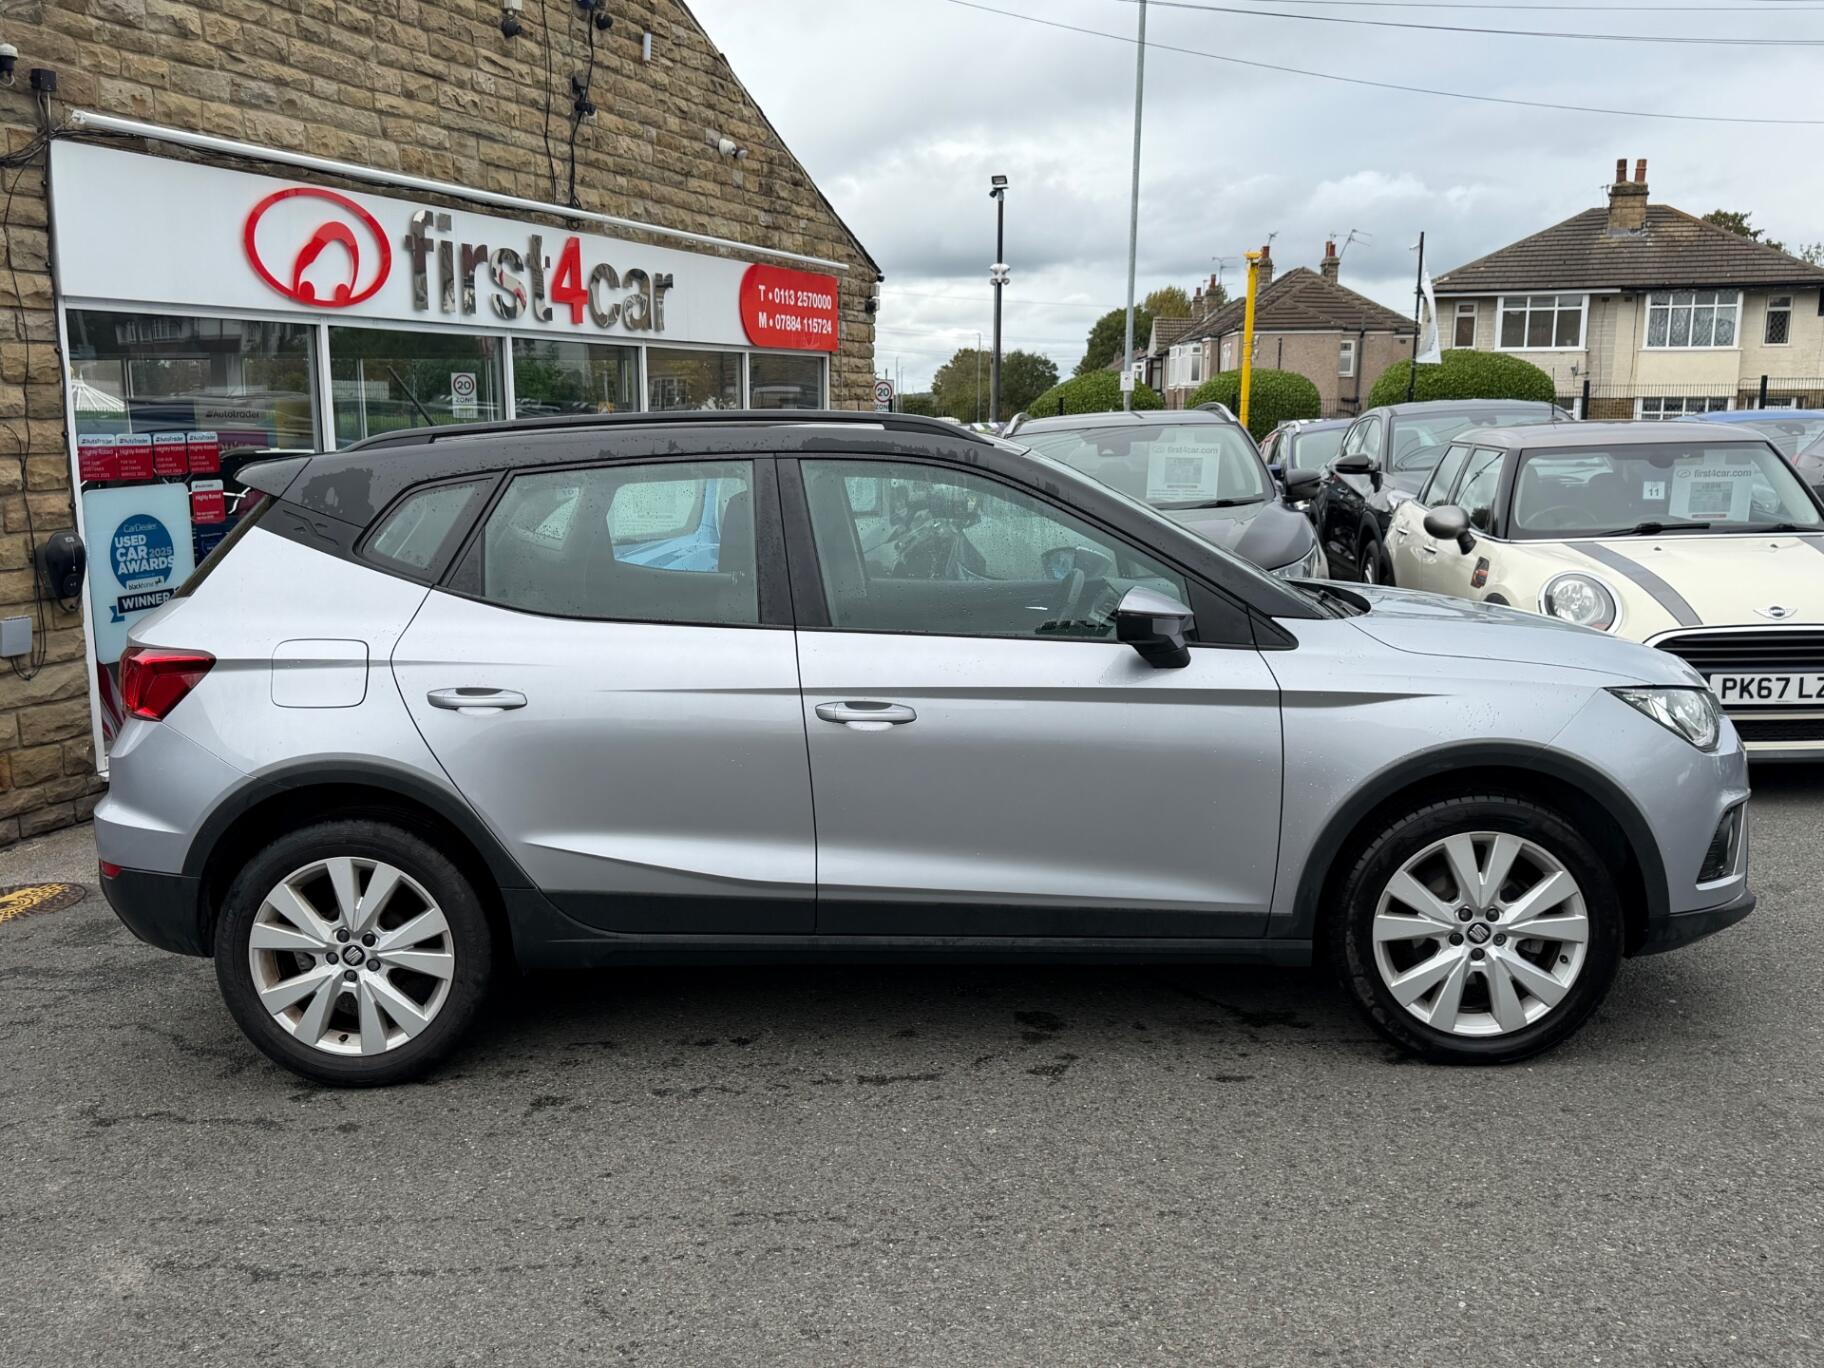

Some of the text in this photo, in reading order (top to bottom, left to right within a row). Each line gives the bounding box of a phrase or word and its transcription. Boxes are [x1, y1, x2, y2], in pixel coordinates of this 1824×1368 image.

[405, 209, 674, 333] first4car
[758, 284, 832, 310] T 0113 2570000
[758, 311, 832, 335] M 07884 115724
[457, 380, 471, 390] 20
[877, 387, 889, 397] 20
[1694, 469, 1752, 479] first4car.com
[1648, 487, 1660, 497] 11
[114, 534, 147, 548] USED
[116, 546, 173, 561] CAR 2025
[118, 555, 175, 575] AWARDS
[122, 591, 171, 610] WINNER
[1721, 677, 1791, 700] PK67
